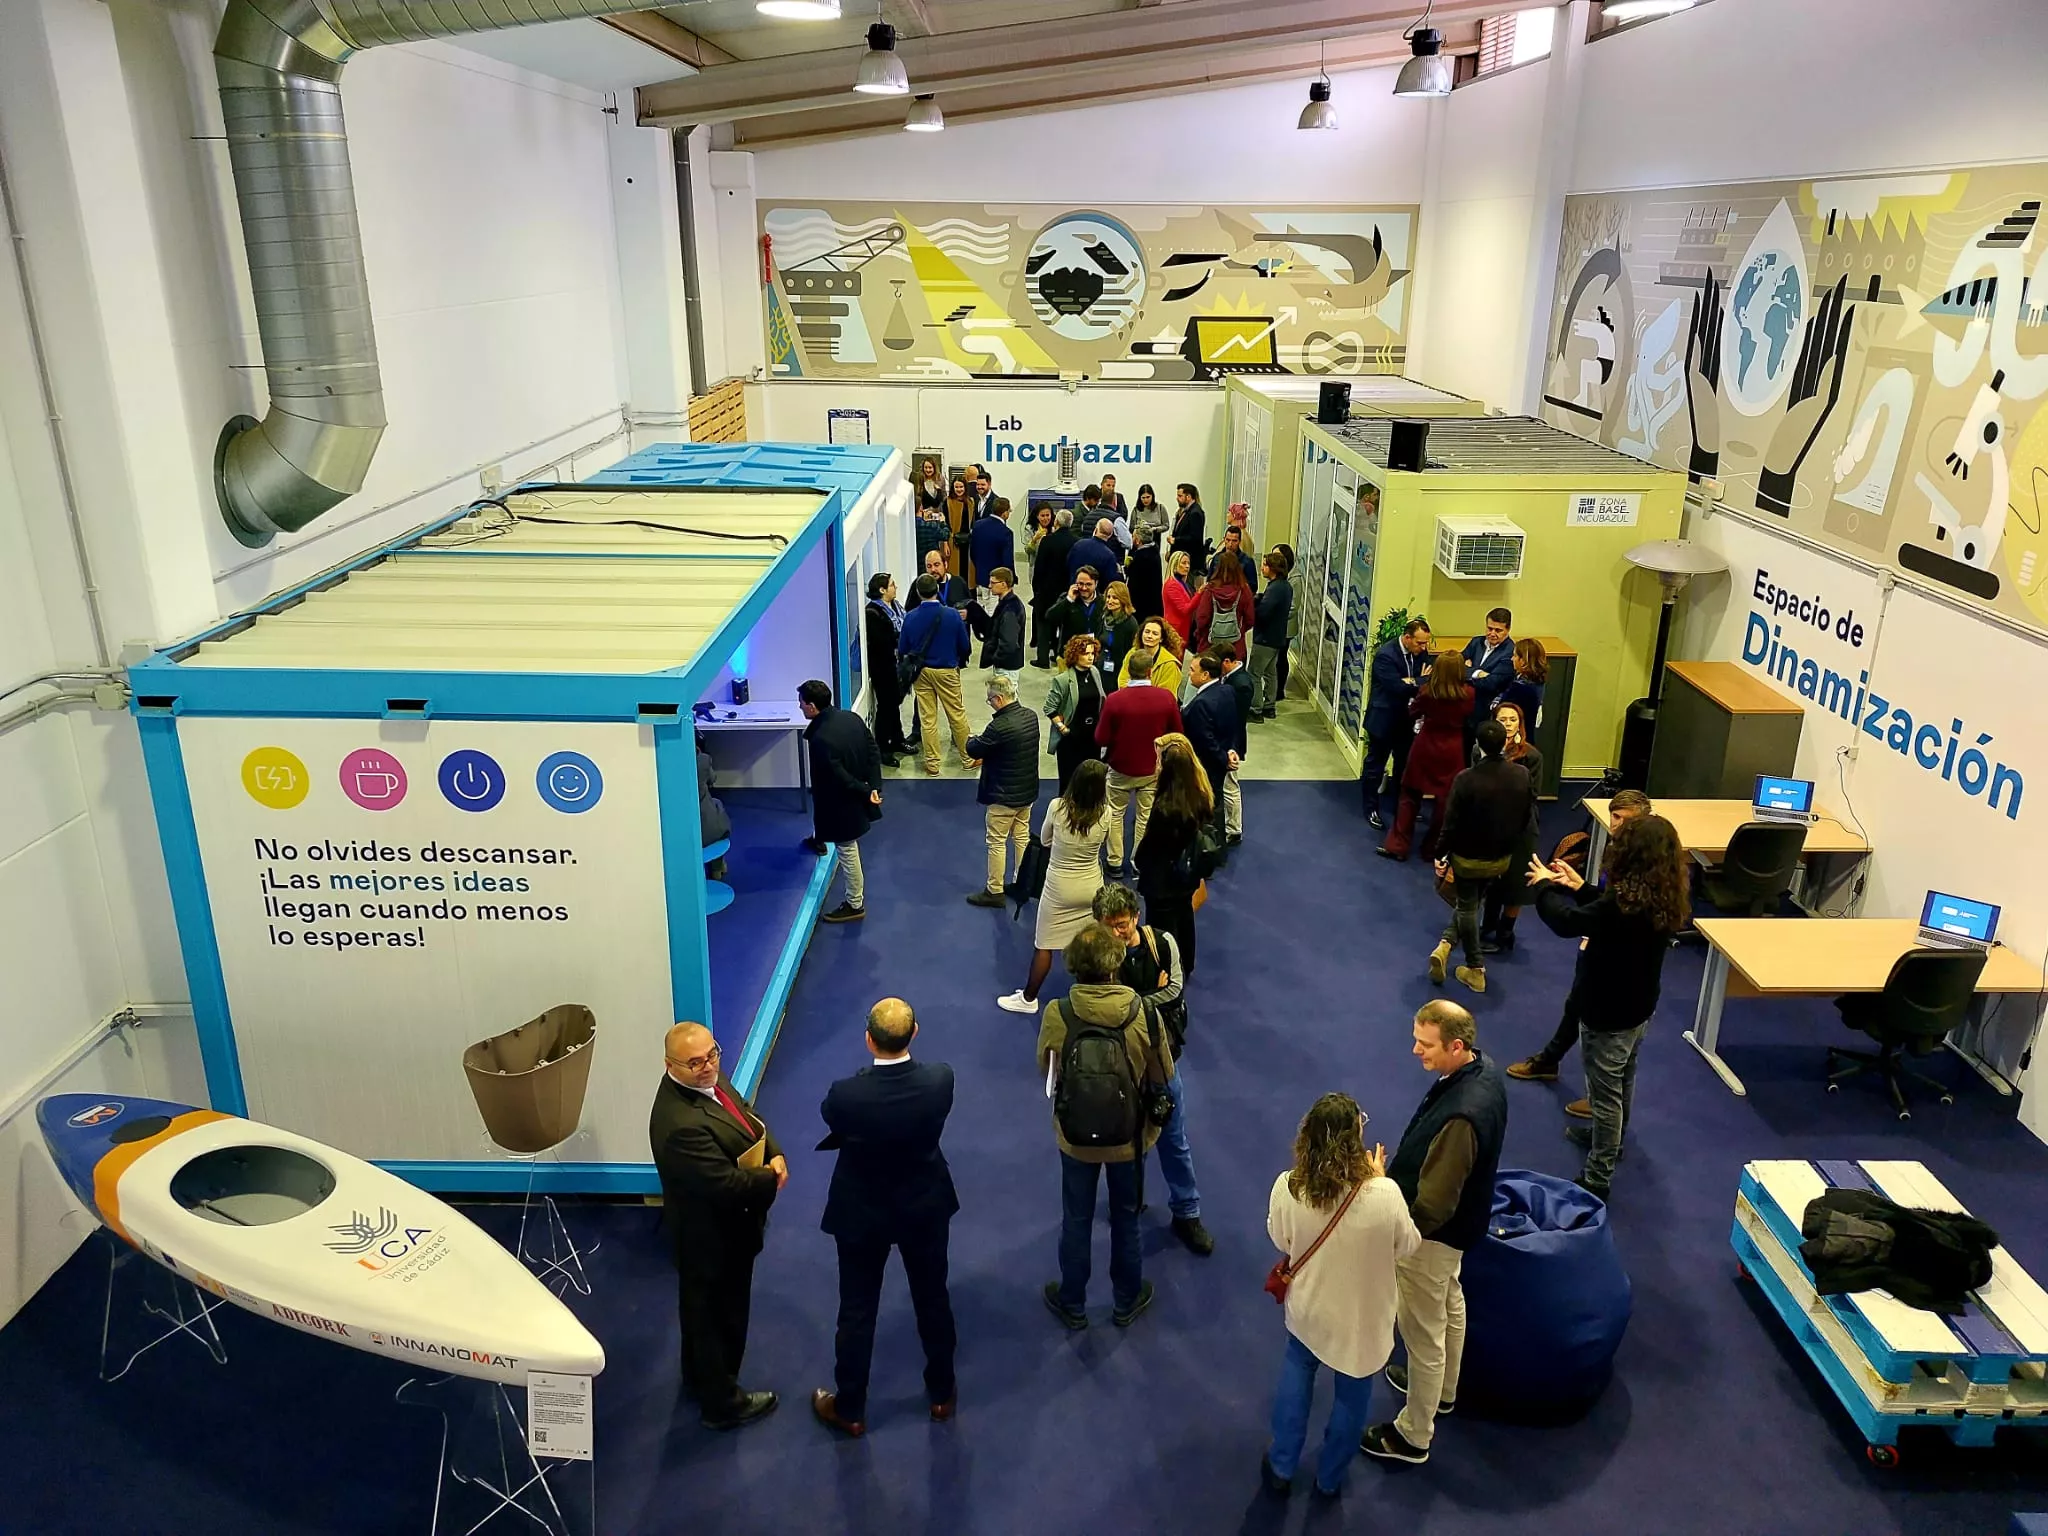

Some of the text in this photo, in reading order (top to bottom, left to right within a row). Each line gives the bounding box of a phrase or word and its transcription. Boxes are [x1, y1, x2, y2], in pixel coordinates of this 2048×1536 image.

[986, 415, 1022, 431] Lab
[1577, 514, 1629, 522] INCUBAZUL
[1753, 568, 1864, 647] Espacio de
[1742, 610, 2024, 820] Dinamización
[255, 838, 577, 864] No olvides descansar.
[260, 868, 530, 896] ¡Las mejores ideas
[264, 896, 569, 923] llegan cuando menos
[269, 925, 425, 951] lo esperas!
[355, 1228, 432, 1270] UCA
[382, 1235, 446, 1280] Universidad
[402, 1247, 450, 1283] de Cádiz
[272, 1303, 351, 1337] ADICORK
[391, 1335, 518, 1369] INNANOMAT
